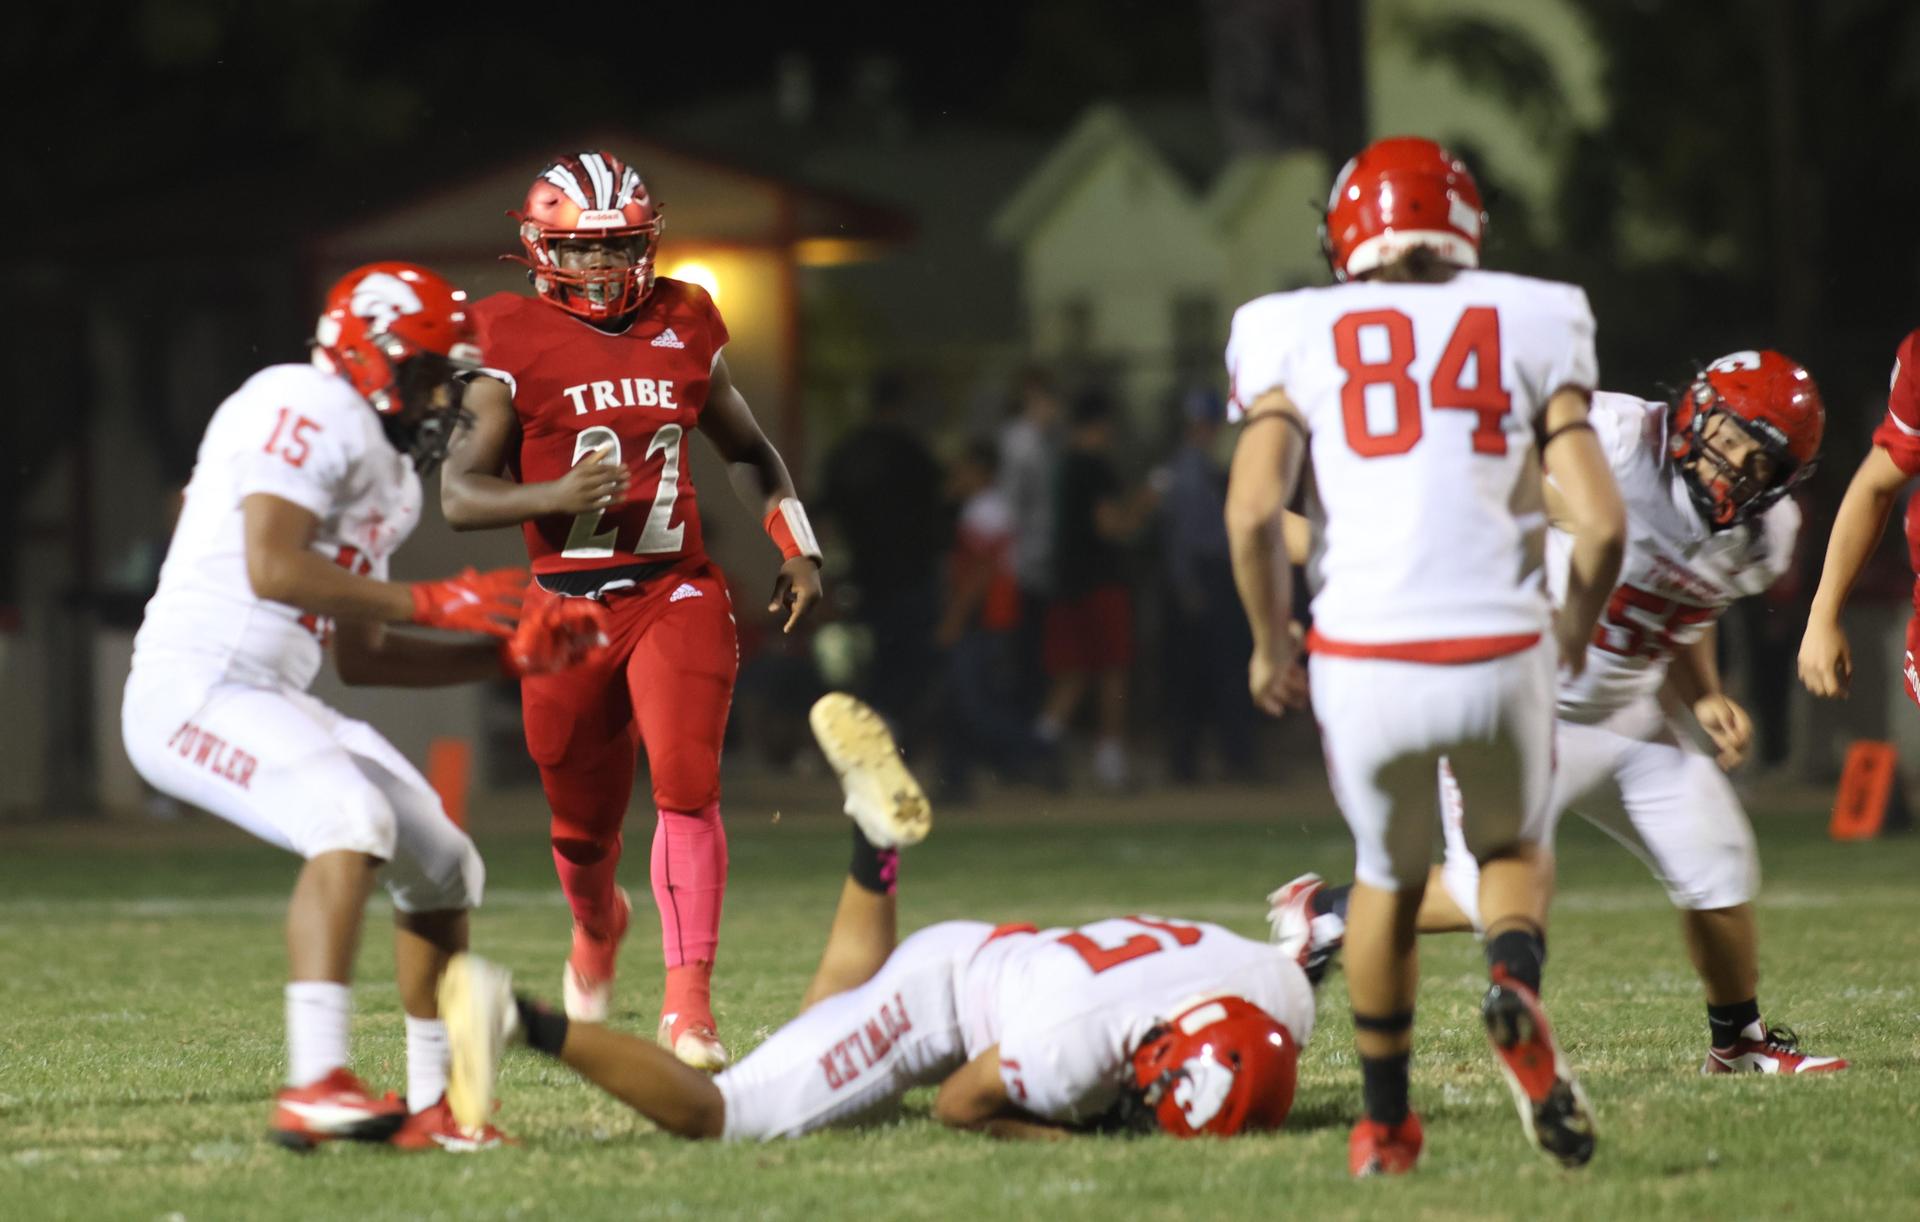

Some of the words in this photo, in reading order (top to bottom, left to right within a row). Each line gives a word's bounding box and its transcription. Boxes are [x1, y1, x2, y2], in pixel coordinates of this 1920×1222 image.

[563, 378, 677, 416] TRIBE
[1333, 305, 1512, 458] 84
[264, 406, 323, 468] 15
[560, 423, 686, 558] 22
